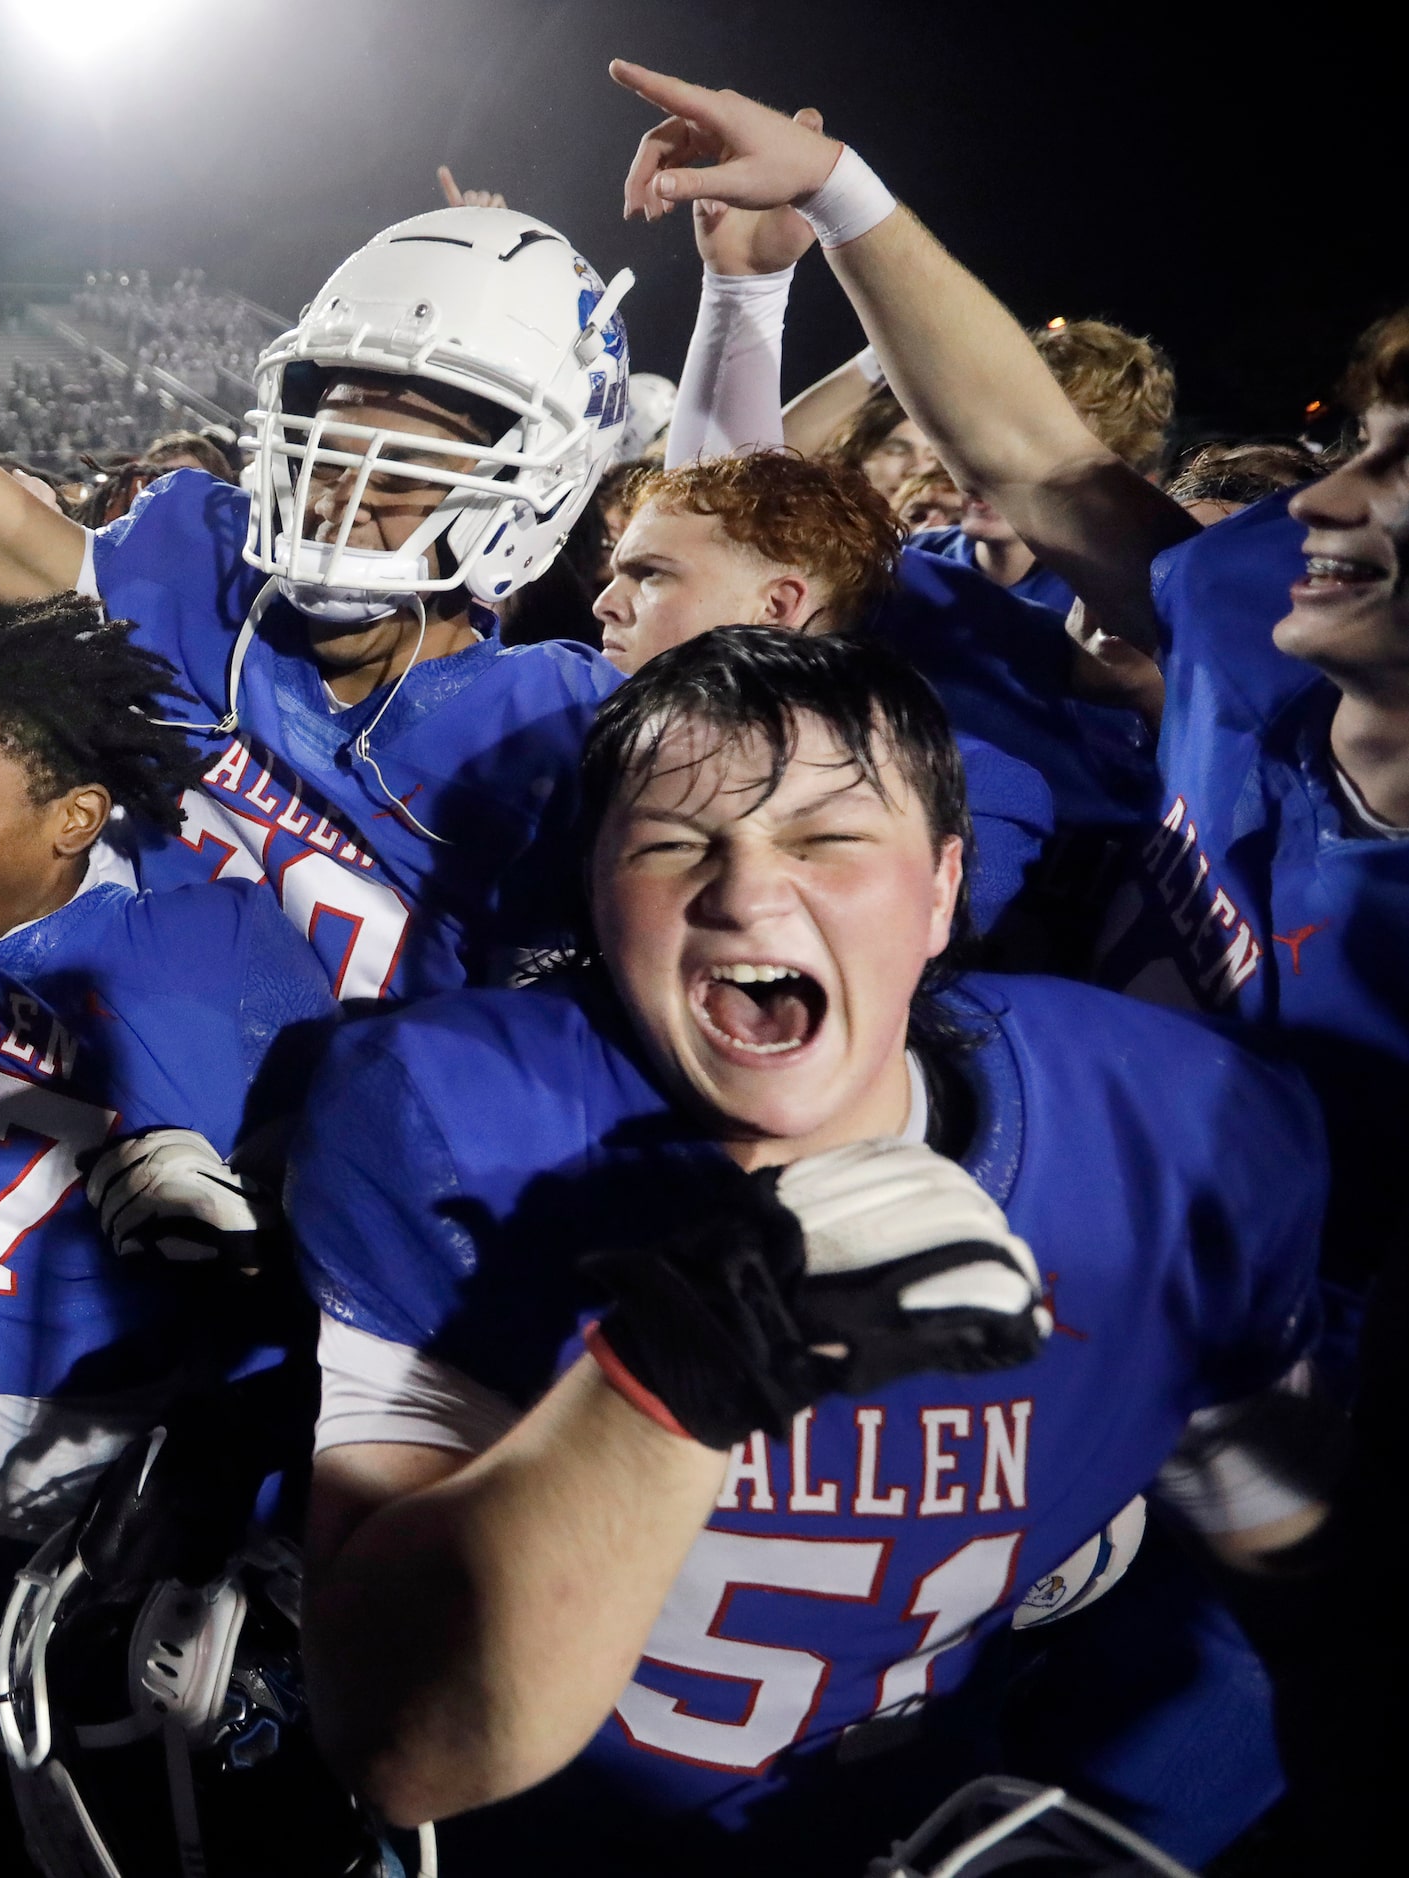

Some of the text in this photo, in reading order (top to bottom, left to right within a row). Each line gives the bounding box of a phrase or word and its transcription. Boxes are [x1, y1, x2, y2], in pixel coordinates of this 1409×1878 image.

[1142, 796, 1263, 1005] ALLEN
[715, 1399, 1033, 1517] ALLEN
[612, 1526, 1026, 1776] 51
